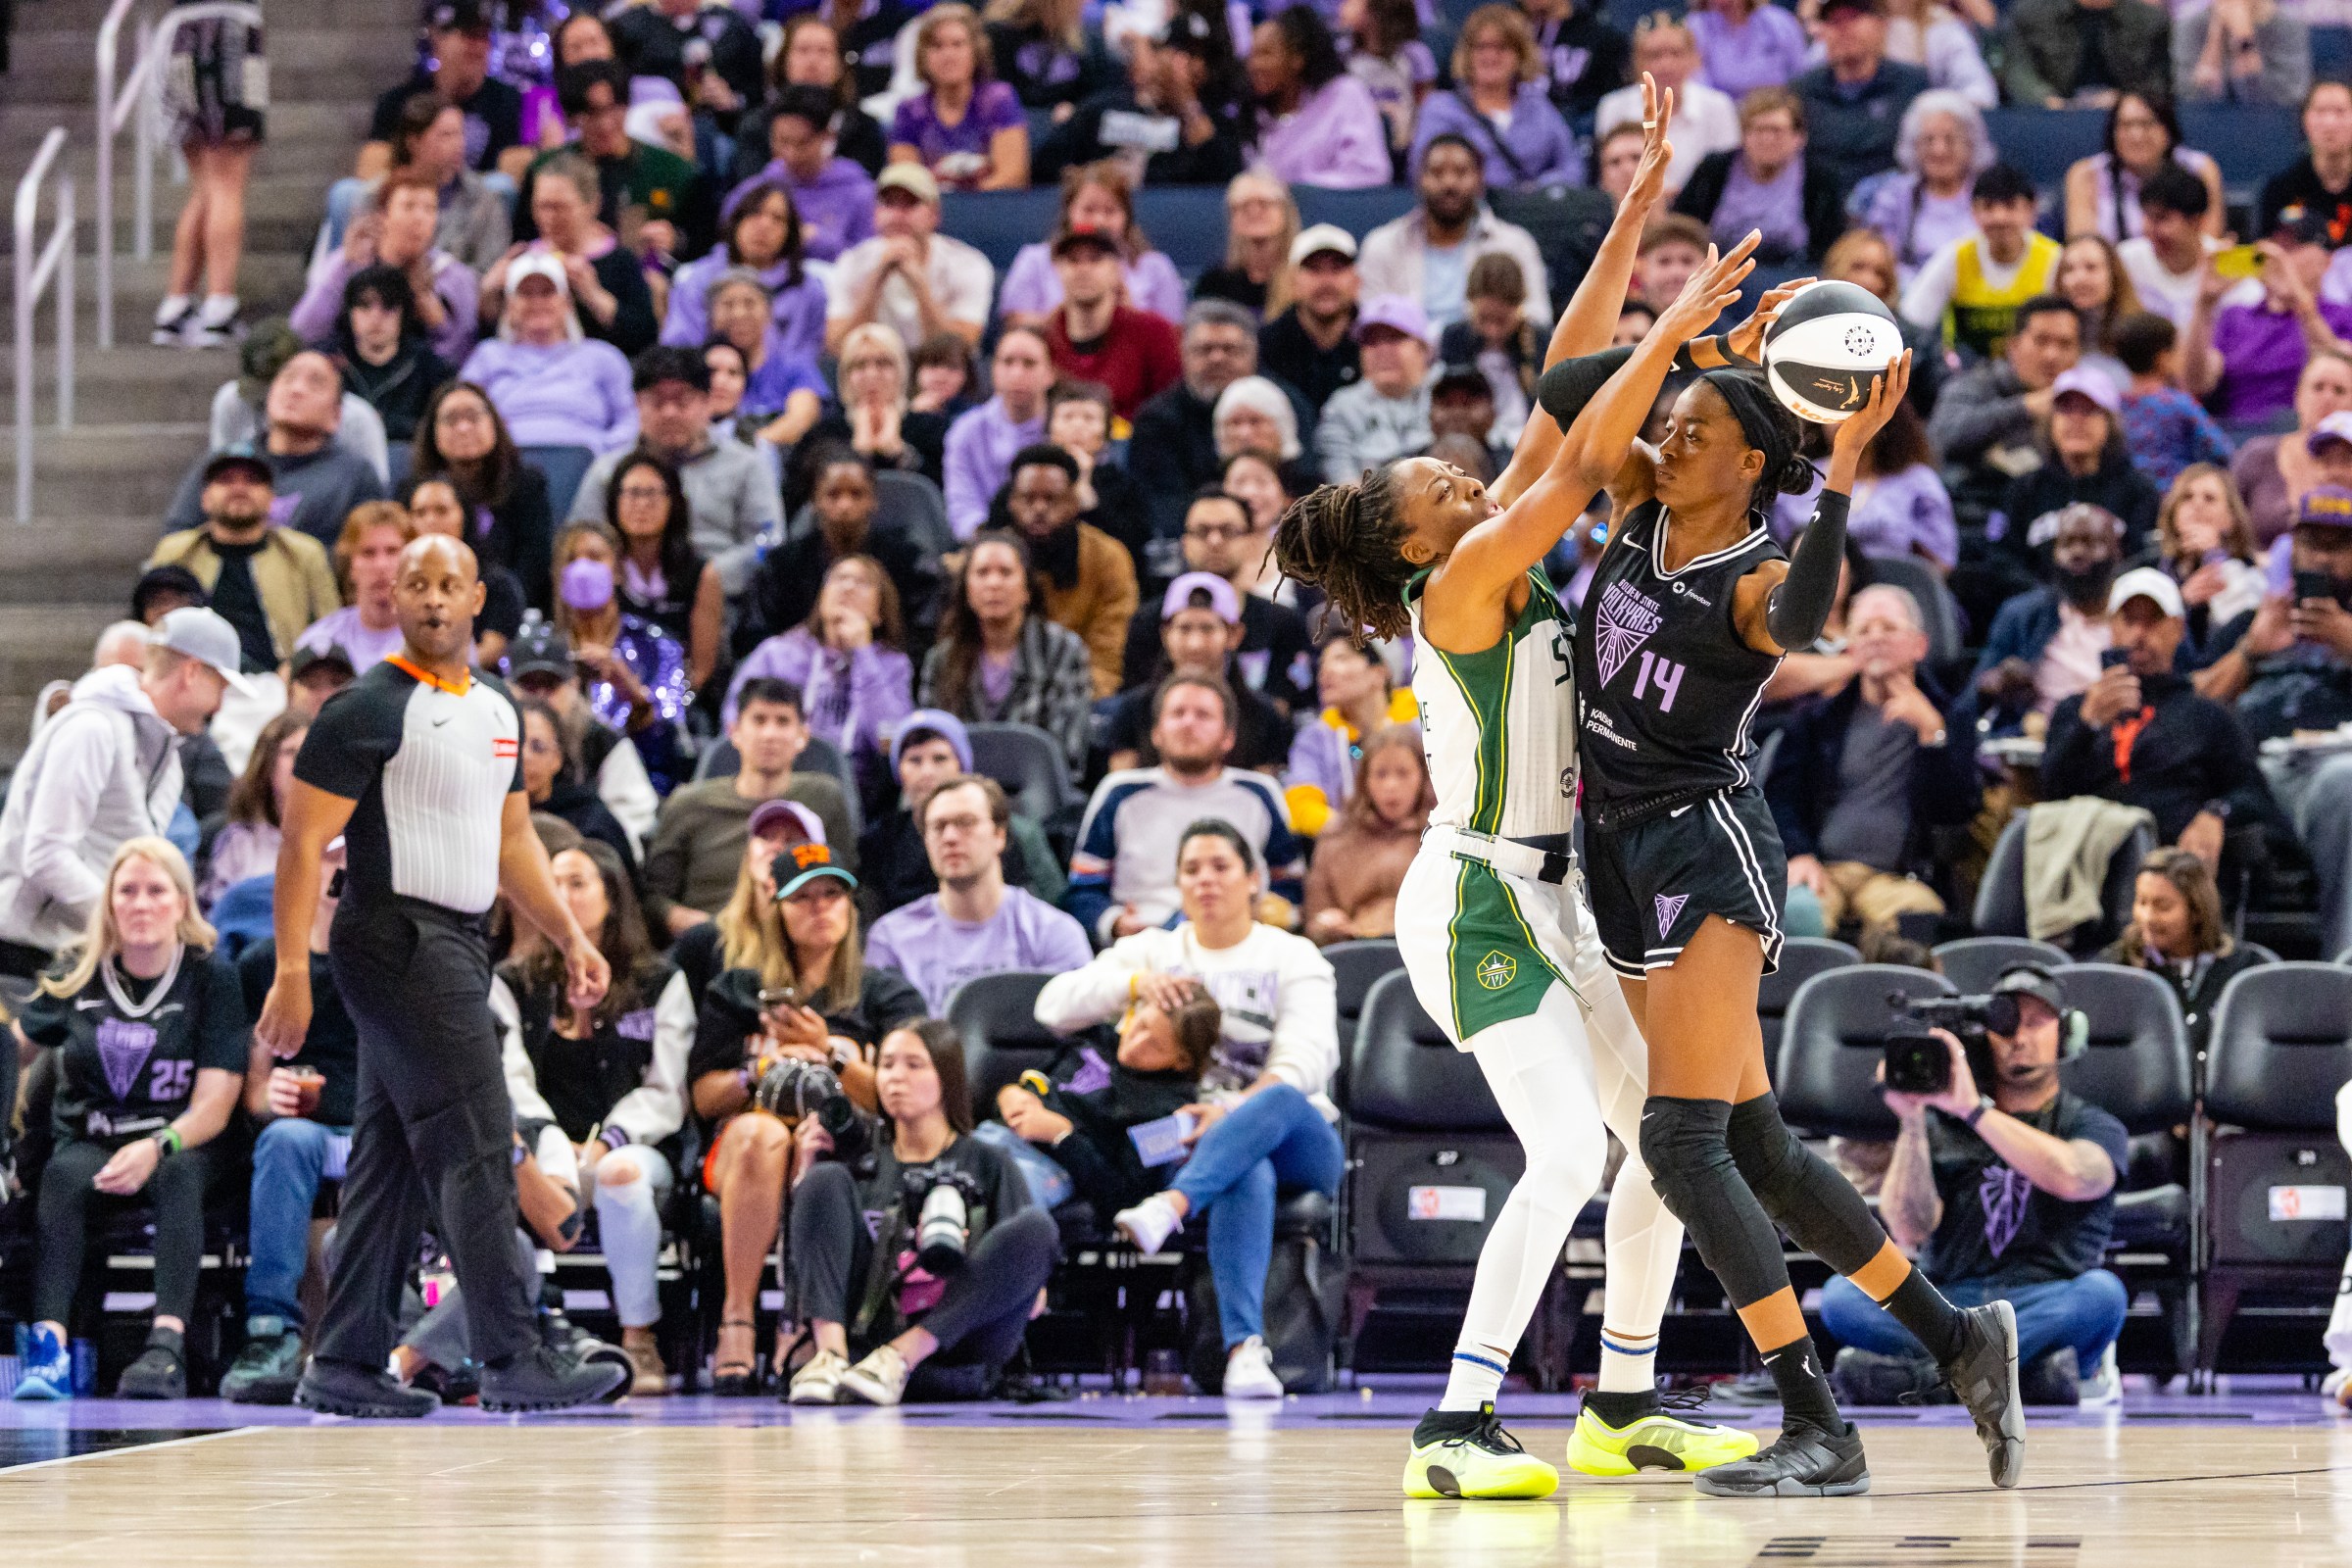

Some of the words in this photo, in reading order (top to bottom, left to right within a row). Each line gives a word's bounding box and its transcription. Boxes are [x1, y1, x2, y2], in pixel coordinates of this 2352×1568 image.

[1601, 581, 1664, 634] VALKYRIES
[1618, 578, 1642, 602] GOLDEN
[1640, 595, 1661, 613] STATE
[1684, 589, 1712, 608] freedom
[1632, 650, 1686, 713] 14
[1586, 719, 1638, 752] PERMANENTE
[149, 1059, 194, 1102] 25
